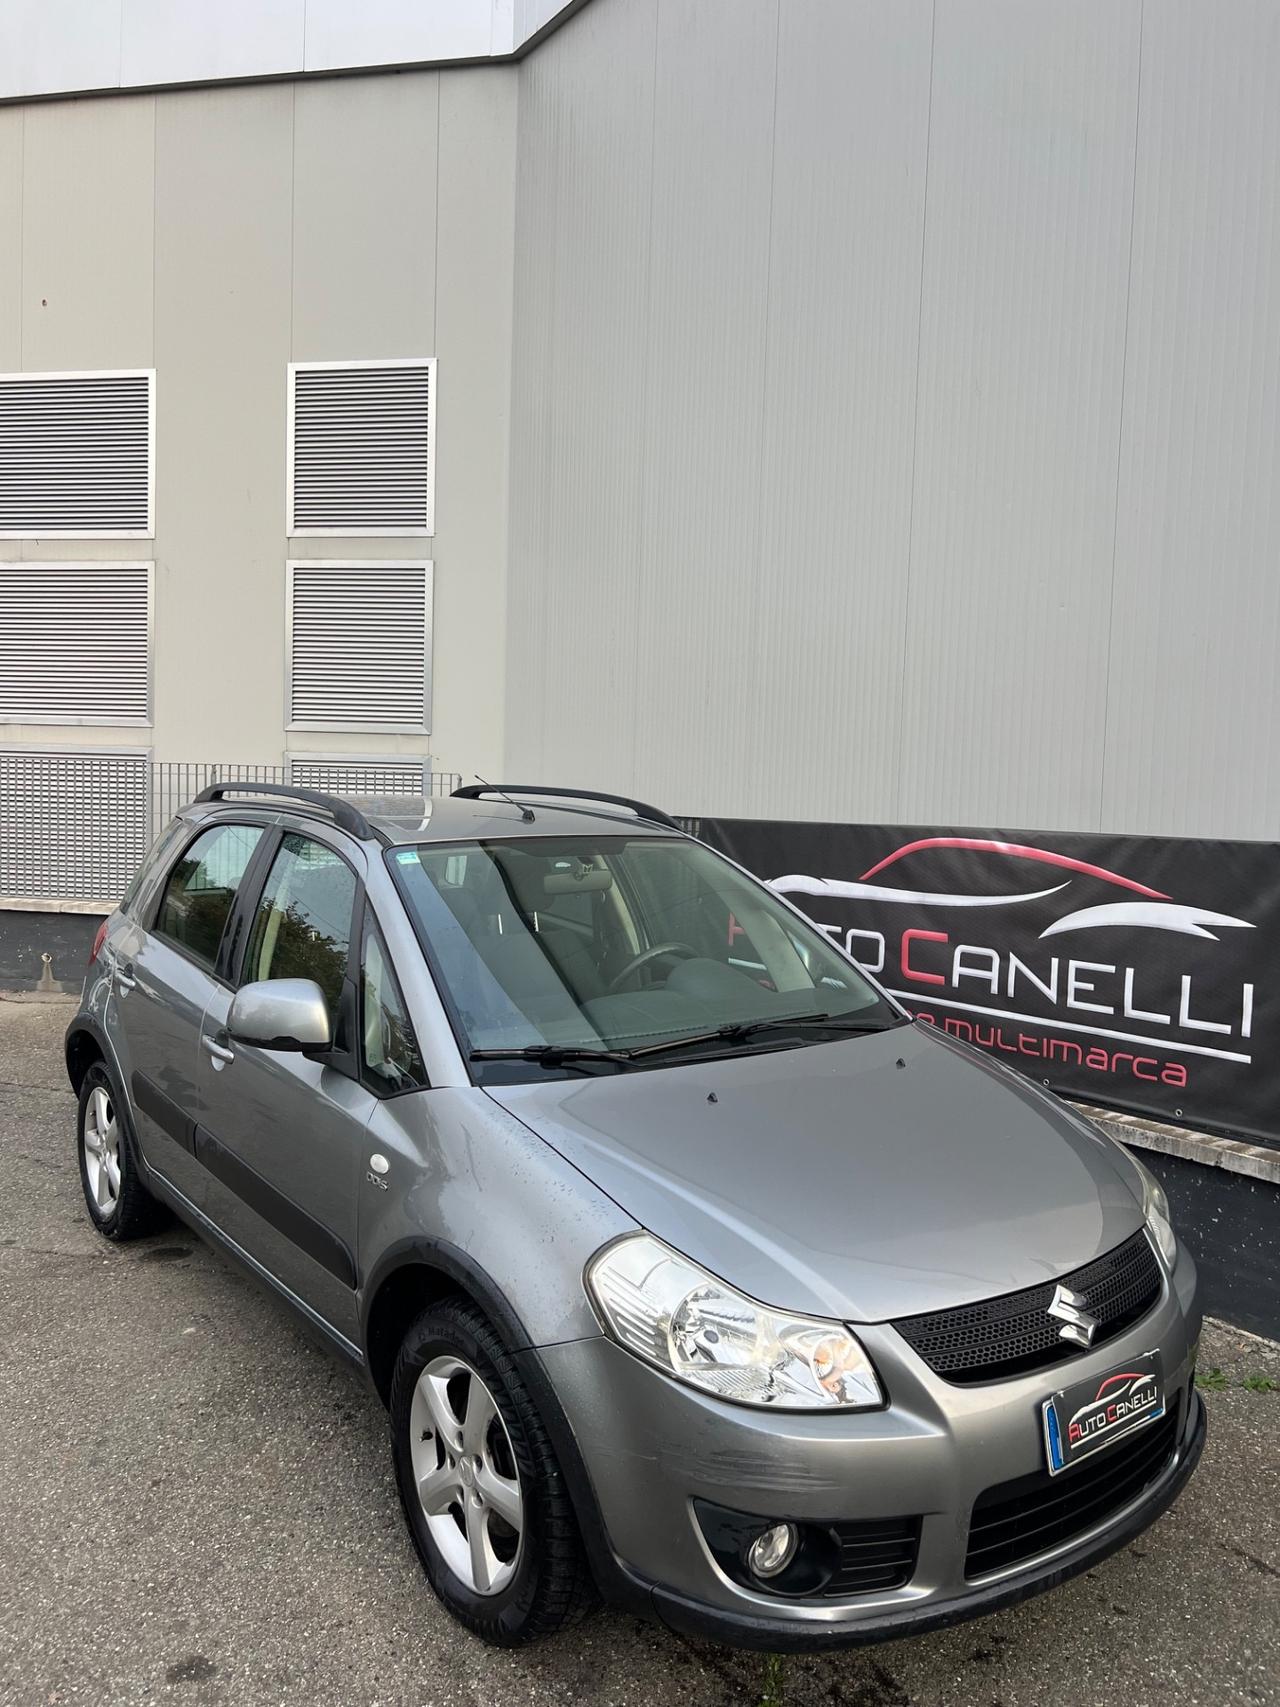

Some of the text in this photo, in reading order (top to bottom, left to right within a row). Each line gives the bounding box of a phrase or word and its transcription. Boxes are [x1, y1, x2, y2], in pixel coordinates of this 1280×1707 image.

[901, 928, 1255, 1038] CANELLI
[1068, 1386, 1157, 1442] AUTO CANELLI
